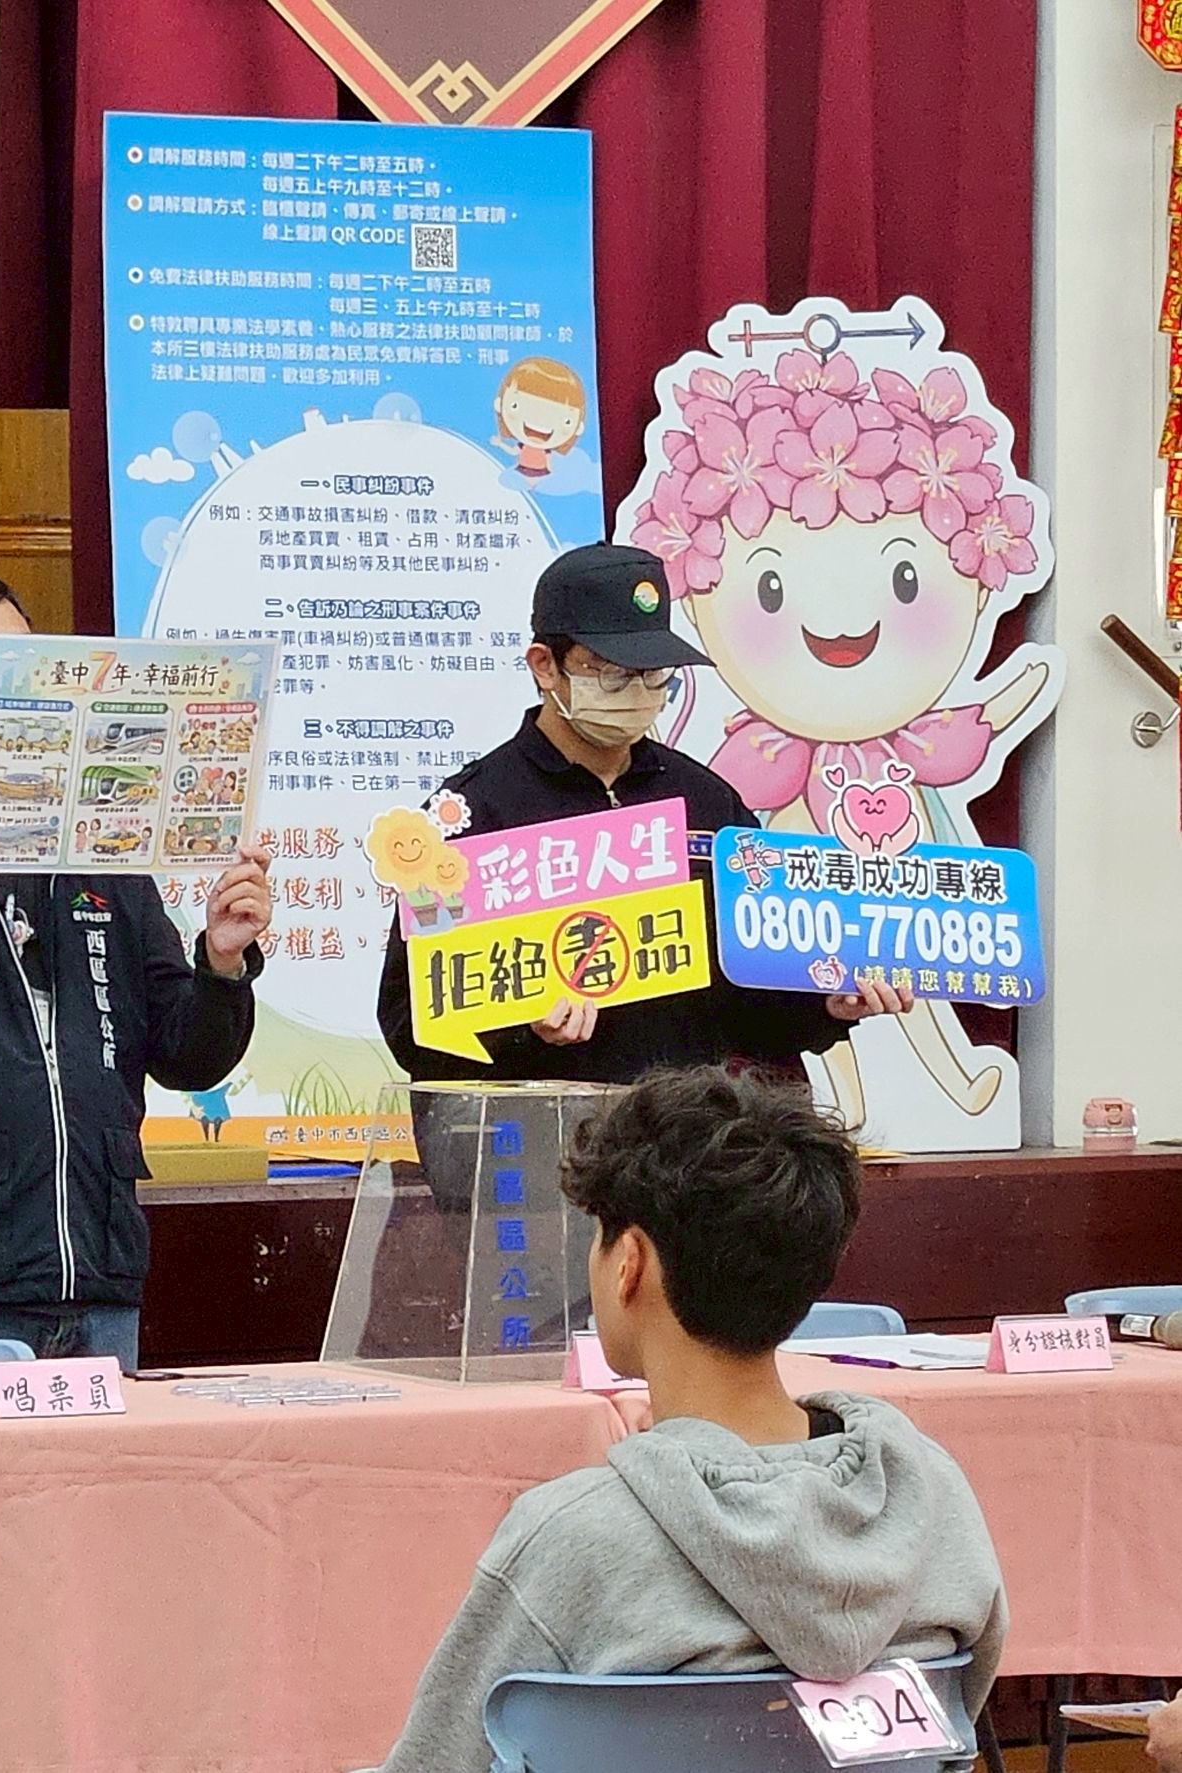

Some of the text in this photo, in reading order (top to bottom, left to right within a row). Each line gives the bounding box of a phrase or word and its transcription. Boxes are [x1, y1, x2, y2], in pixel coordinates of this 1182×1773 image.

[331, 226, 356, 245] QR
[359, 227, 406, 244] CODE
[300, 475, 434, 495] 一、民事糾紛事件
[303, 719, 455, 740] 三、不得調解之事件
[478, 817, 678, 911] 彩色人生
[784, 846, 1009, 903] 戒毒成功專線
[734, 893, 1022, 968] 0800-770885
[425, 908, 692, 1020] 拒絕毒品
[2, 1374, 111, 1413] 唱票員
